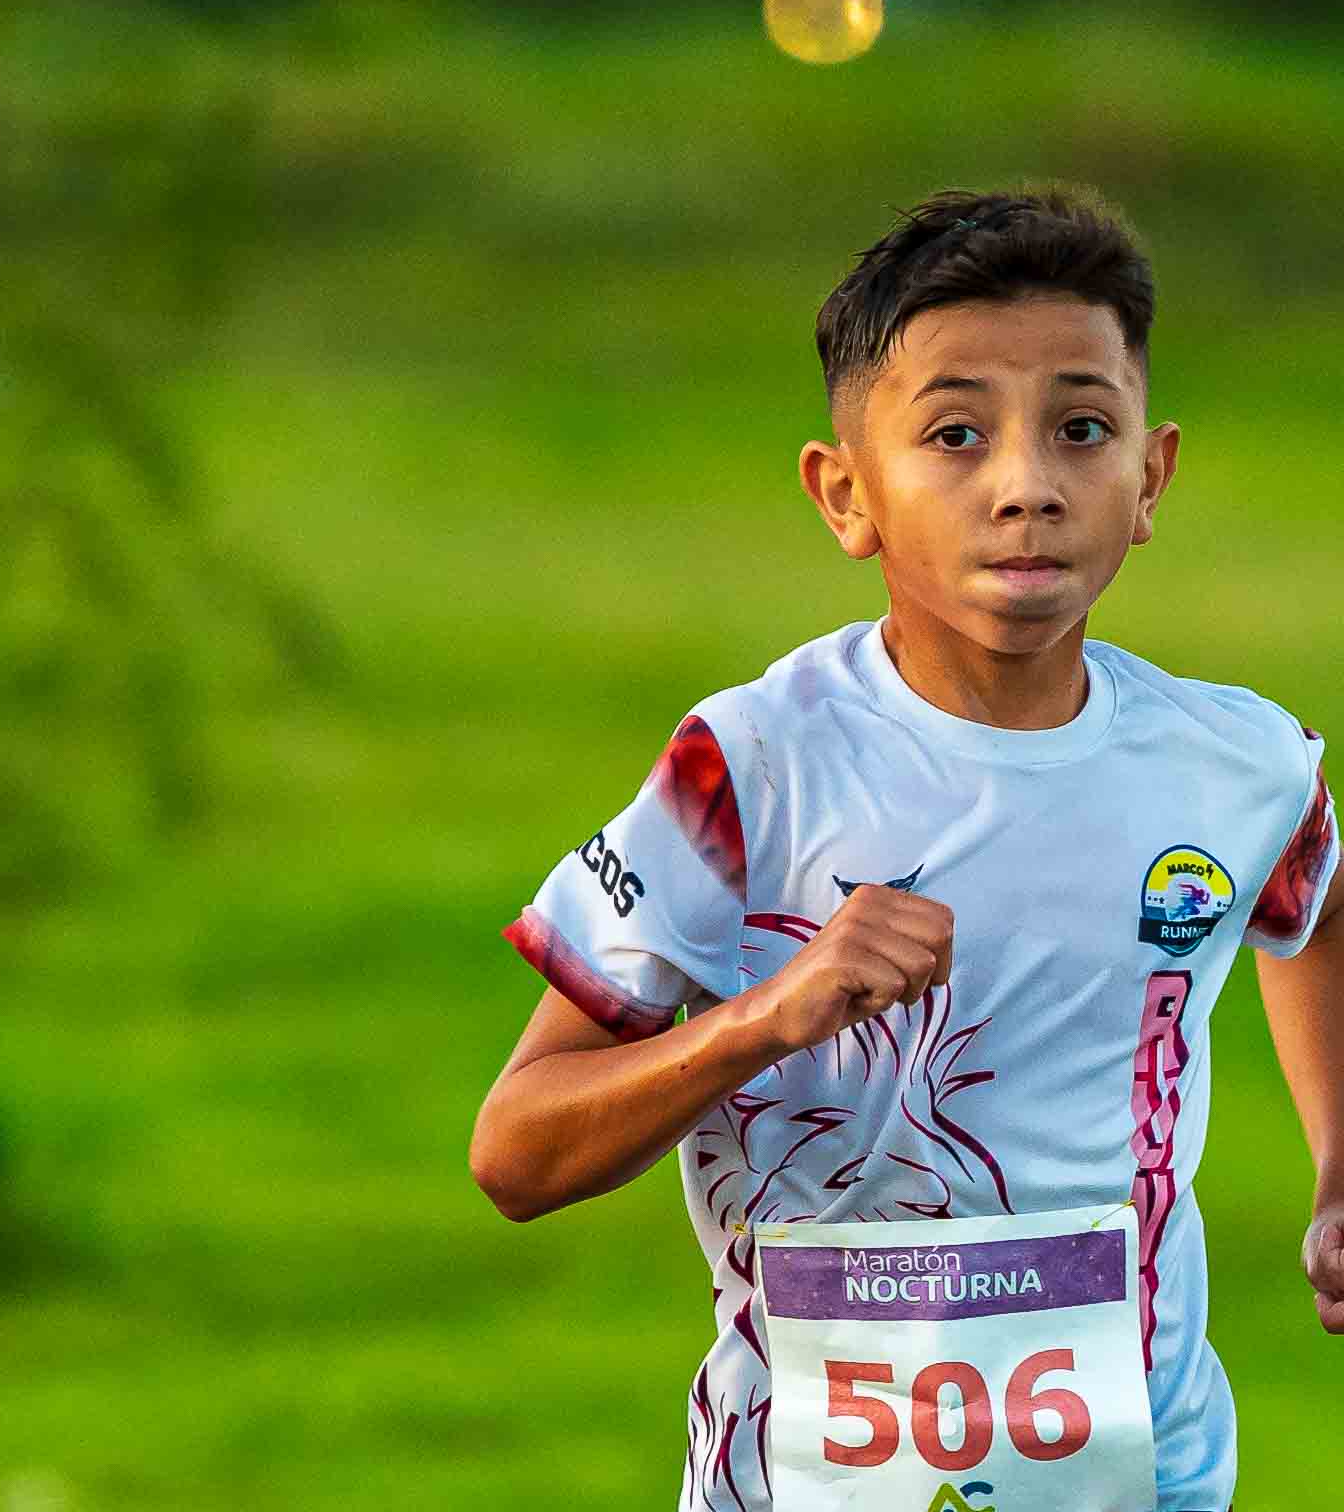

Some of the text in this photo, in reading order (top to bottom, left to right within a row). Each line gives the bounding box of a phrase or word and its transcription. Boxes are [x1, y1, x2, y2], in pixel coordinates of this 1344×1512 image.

[843, 1246, 961, 1273] Maratón
[844, 1267, 1043, 1303] NOCTURNA
[823, 1348, 1092, 1472] 506
